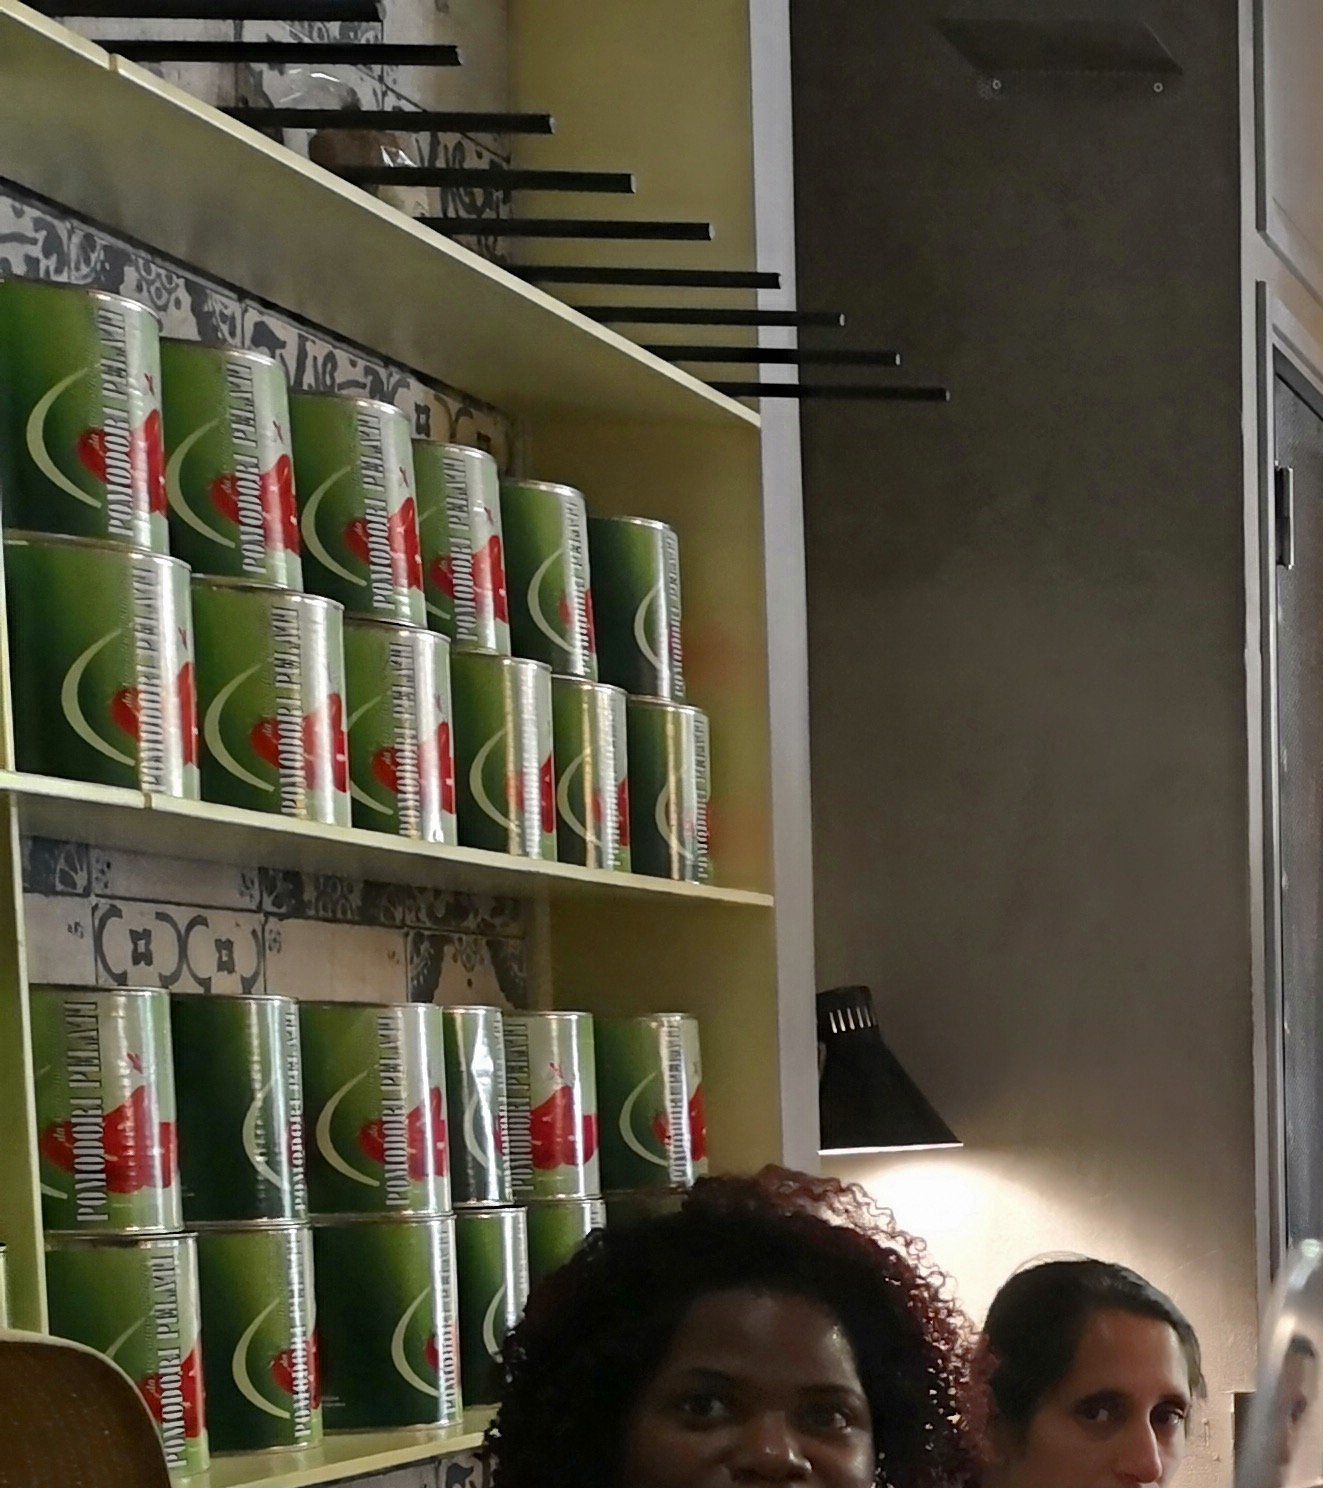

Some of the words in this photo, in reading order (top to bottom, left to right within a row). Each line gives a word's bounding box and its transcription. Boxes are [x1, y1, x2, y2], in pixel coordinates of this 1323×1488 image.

[97, 308, 129, 400] PELATI
[226, 361, 257, 448] PELATI
[103, 407, 134, 536] POMODORI
[357, 412, 385, 491] PELATI
[443, 457, 470, 530] PELATI
[233, 454, 266, 573] POMODORI
[364, 499, 395, 609] POMODORI
[132, 566, 159, 653] PELATI
[449, 537, 478, 642] POMODORI
[271, 606, 301, 689] PELATI
[389, 642, 415, 725] PELATI
[136, 665, 166, 793] POMODORI
[275, 696, 307, 815] POMODORI
[394, 728, 421, 838] POMODORI
[63, 1001, 101, 1088] PELATI
[378, 1016, 404, 1089] PELATI
[504, 1023, 530, 1089] PELATI
[69, 1096, 108, 1221] POMODORI
[381, 1098, 410, 1205] POMODORI
[506, 1098, 534, 1190] POMODORI
[151, 1255, 180, 1340] PELATI
[157, 1347, 187, 1468] POMODORI
[289, 1327, 312, 1437] POMODORI
